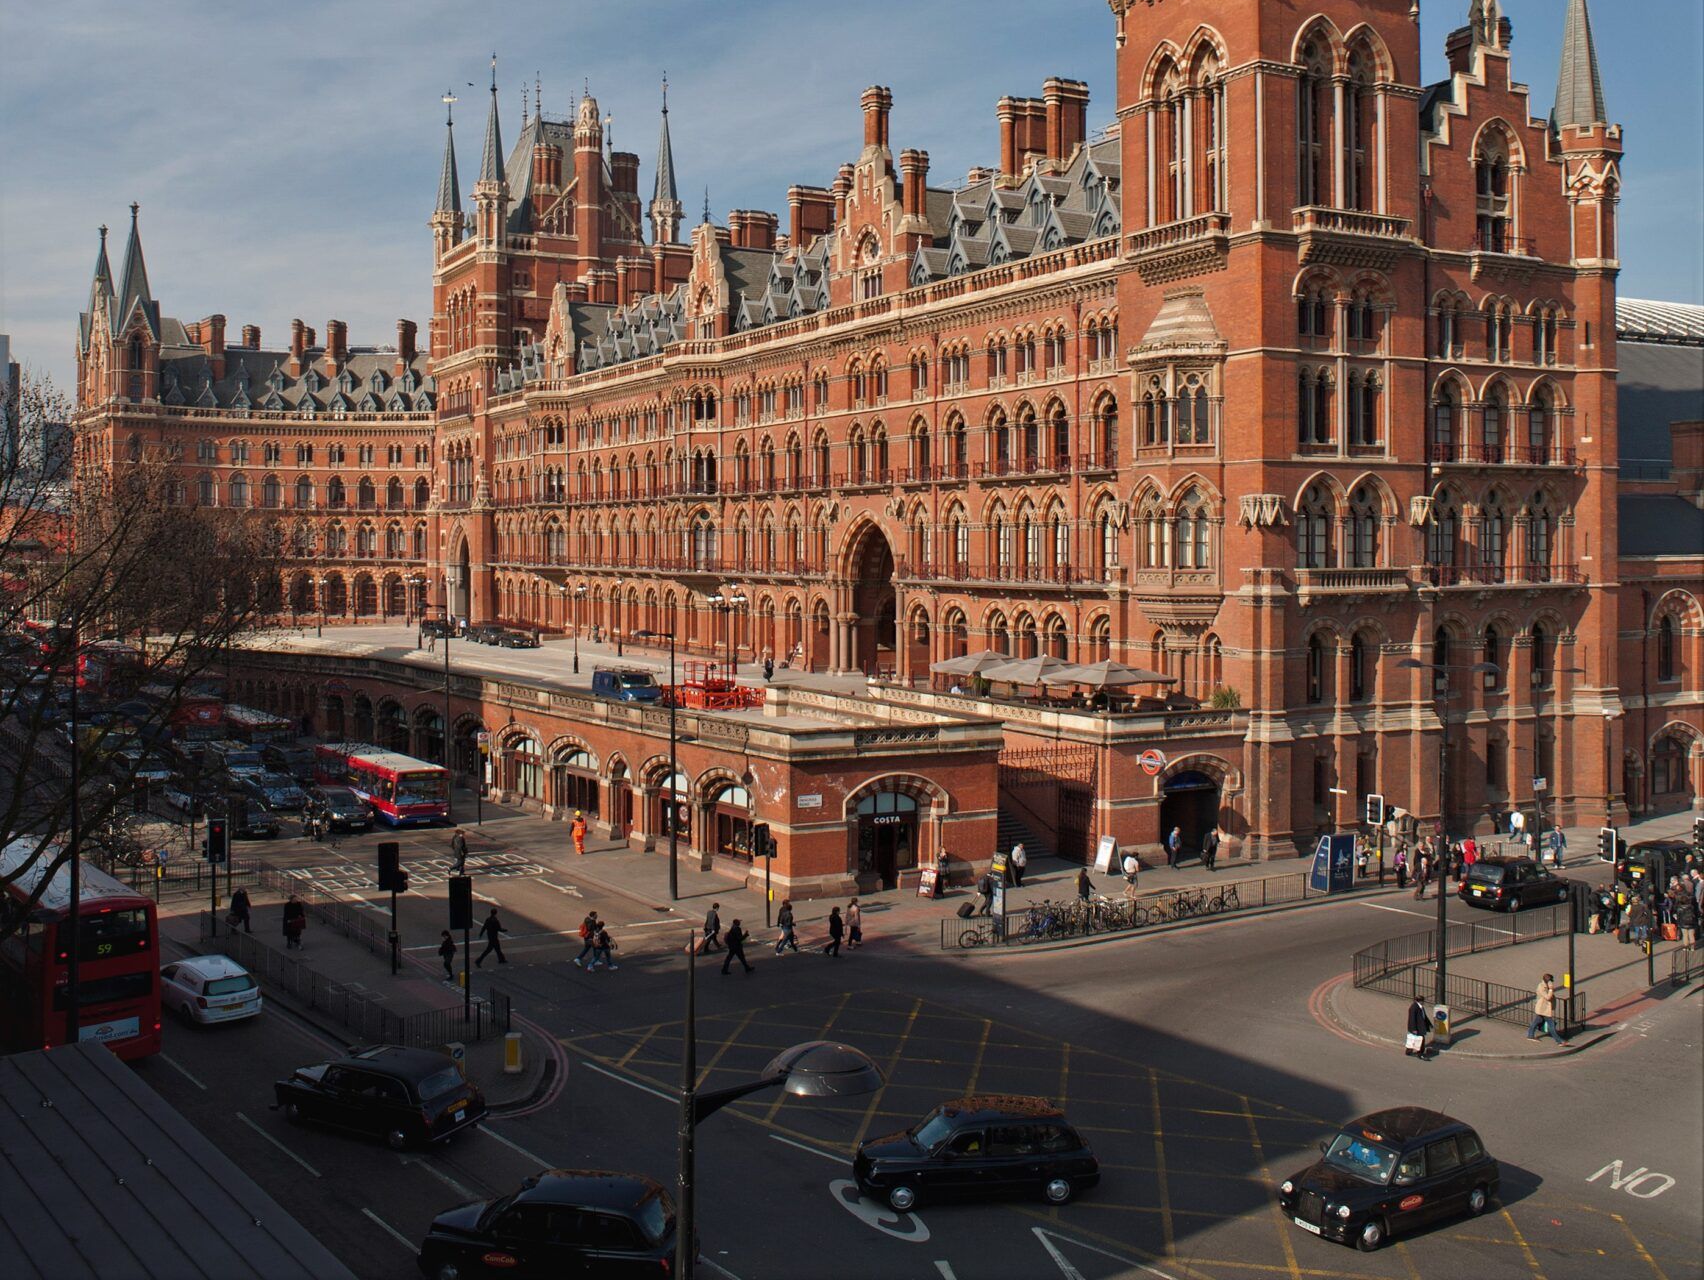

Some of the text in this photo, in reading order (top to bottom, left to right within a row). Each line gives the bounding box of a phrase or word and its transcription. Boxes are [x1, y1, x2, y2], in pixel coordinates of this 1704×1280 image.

[874, 816, 900, 824] COSTA
[97, 943, 113, 955] 59
[1585, 1159, 1676, 1198] NO
